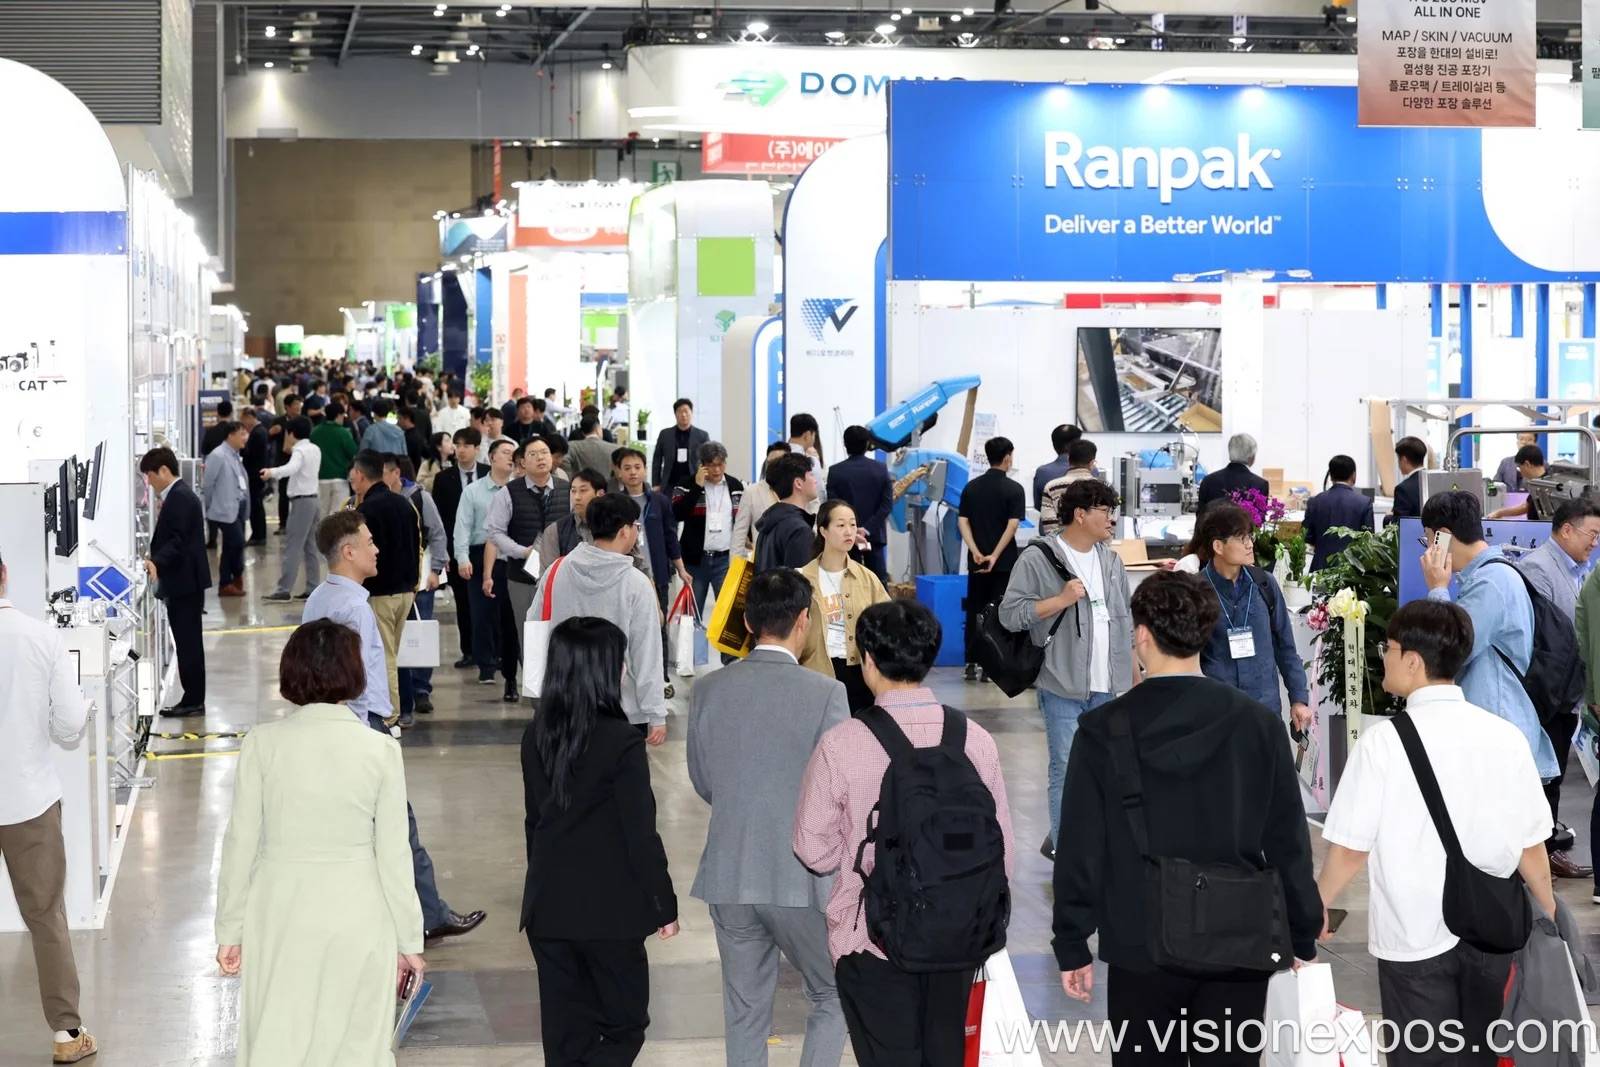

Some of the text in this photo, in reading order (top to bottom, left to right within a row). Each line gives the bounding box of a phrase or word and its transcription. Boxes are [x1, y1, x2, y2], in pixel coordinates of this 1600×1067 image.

[1414, 6, 1481, 18] ALL IN ONE
[1382, 30, 1513, 43] MAP / SKIN / VACUUM
[1397, 47, 1498, 60] 포장을 한대의 설비로!
[1403, 63, 1491, 76] 열성형 진공 포장기
[1432, 80, 1438, 93] /
[1441, 81, 1493, 93] 트레이실러
[1495, 82, 1506, 94] 등
[1402, 97, 1492, 110] 다양한 포장 솔루션
[1044, 131, 1278, 204] Ranpak
[1045, 214, 1120, 234] Deliver
[1124, 219, 1136, 234] a
[1141, 215, 1207, 234] Better
